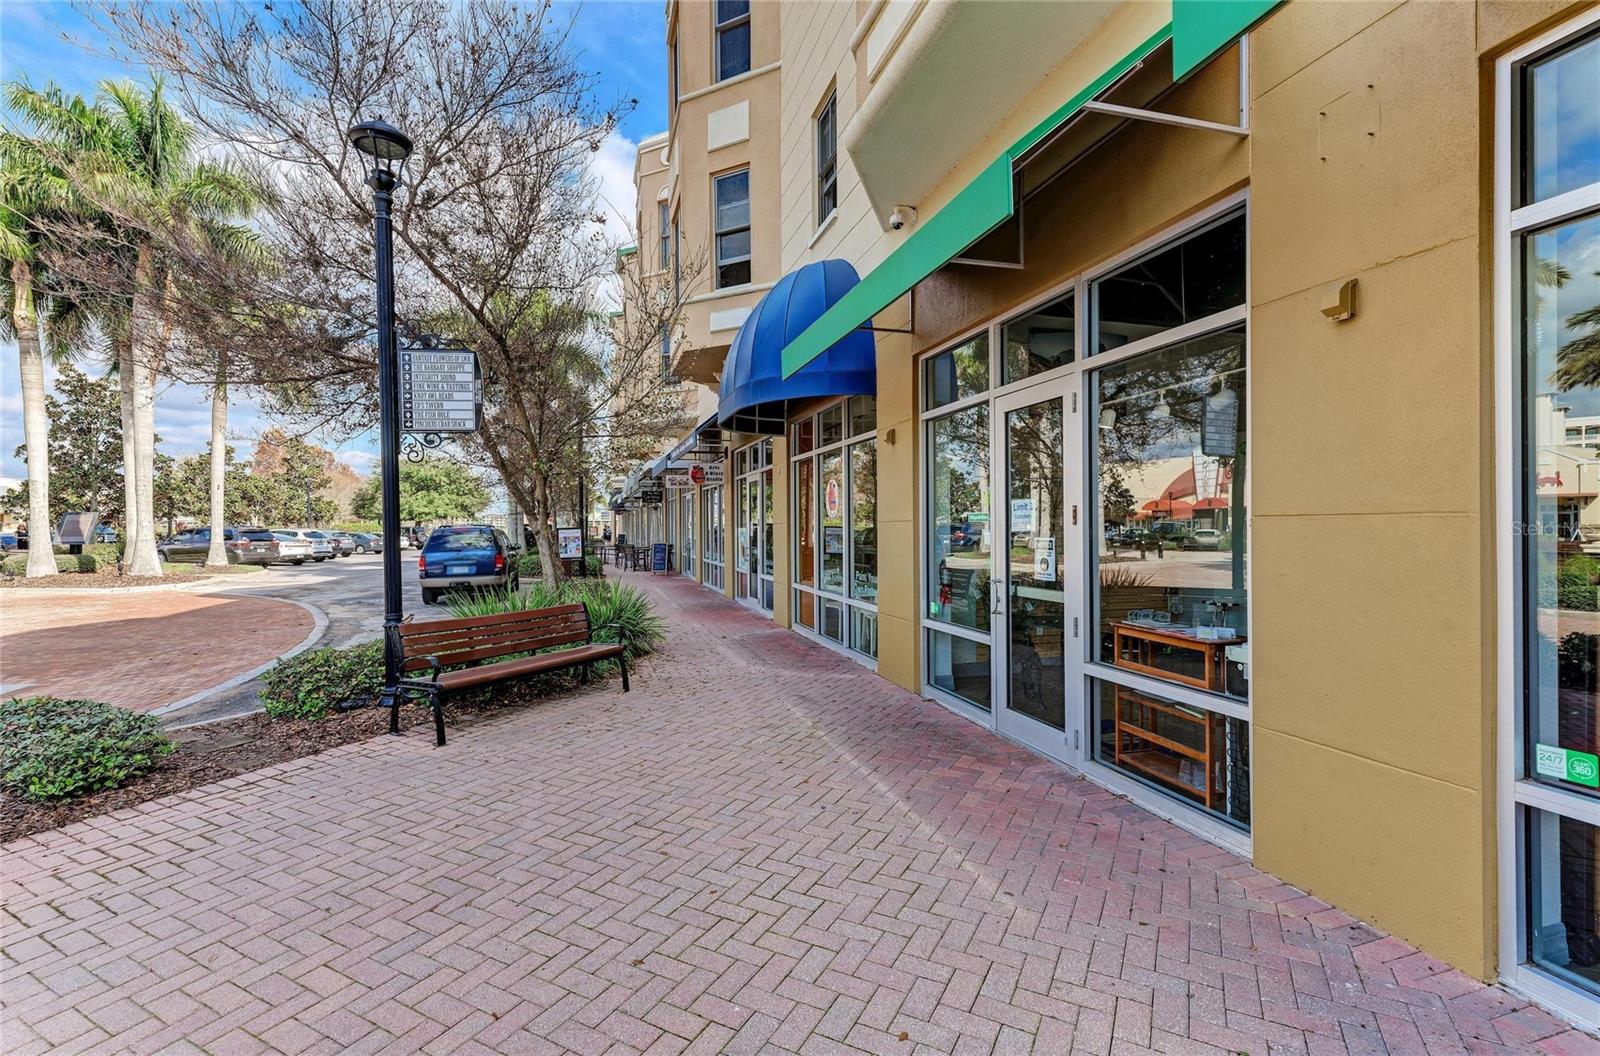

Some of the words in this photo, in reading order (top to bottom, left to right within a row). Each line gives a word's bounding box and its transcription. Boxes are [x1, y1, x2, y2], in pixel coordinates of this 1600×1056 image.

[440, 373, 456, 381] SOUND
[1013, 502, 1028, 511] Limit
[1539, 752, 1563, 765] 24/7
[1573, 766, 1592, 776] 360
